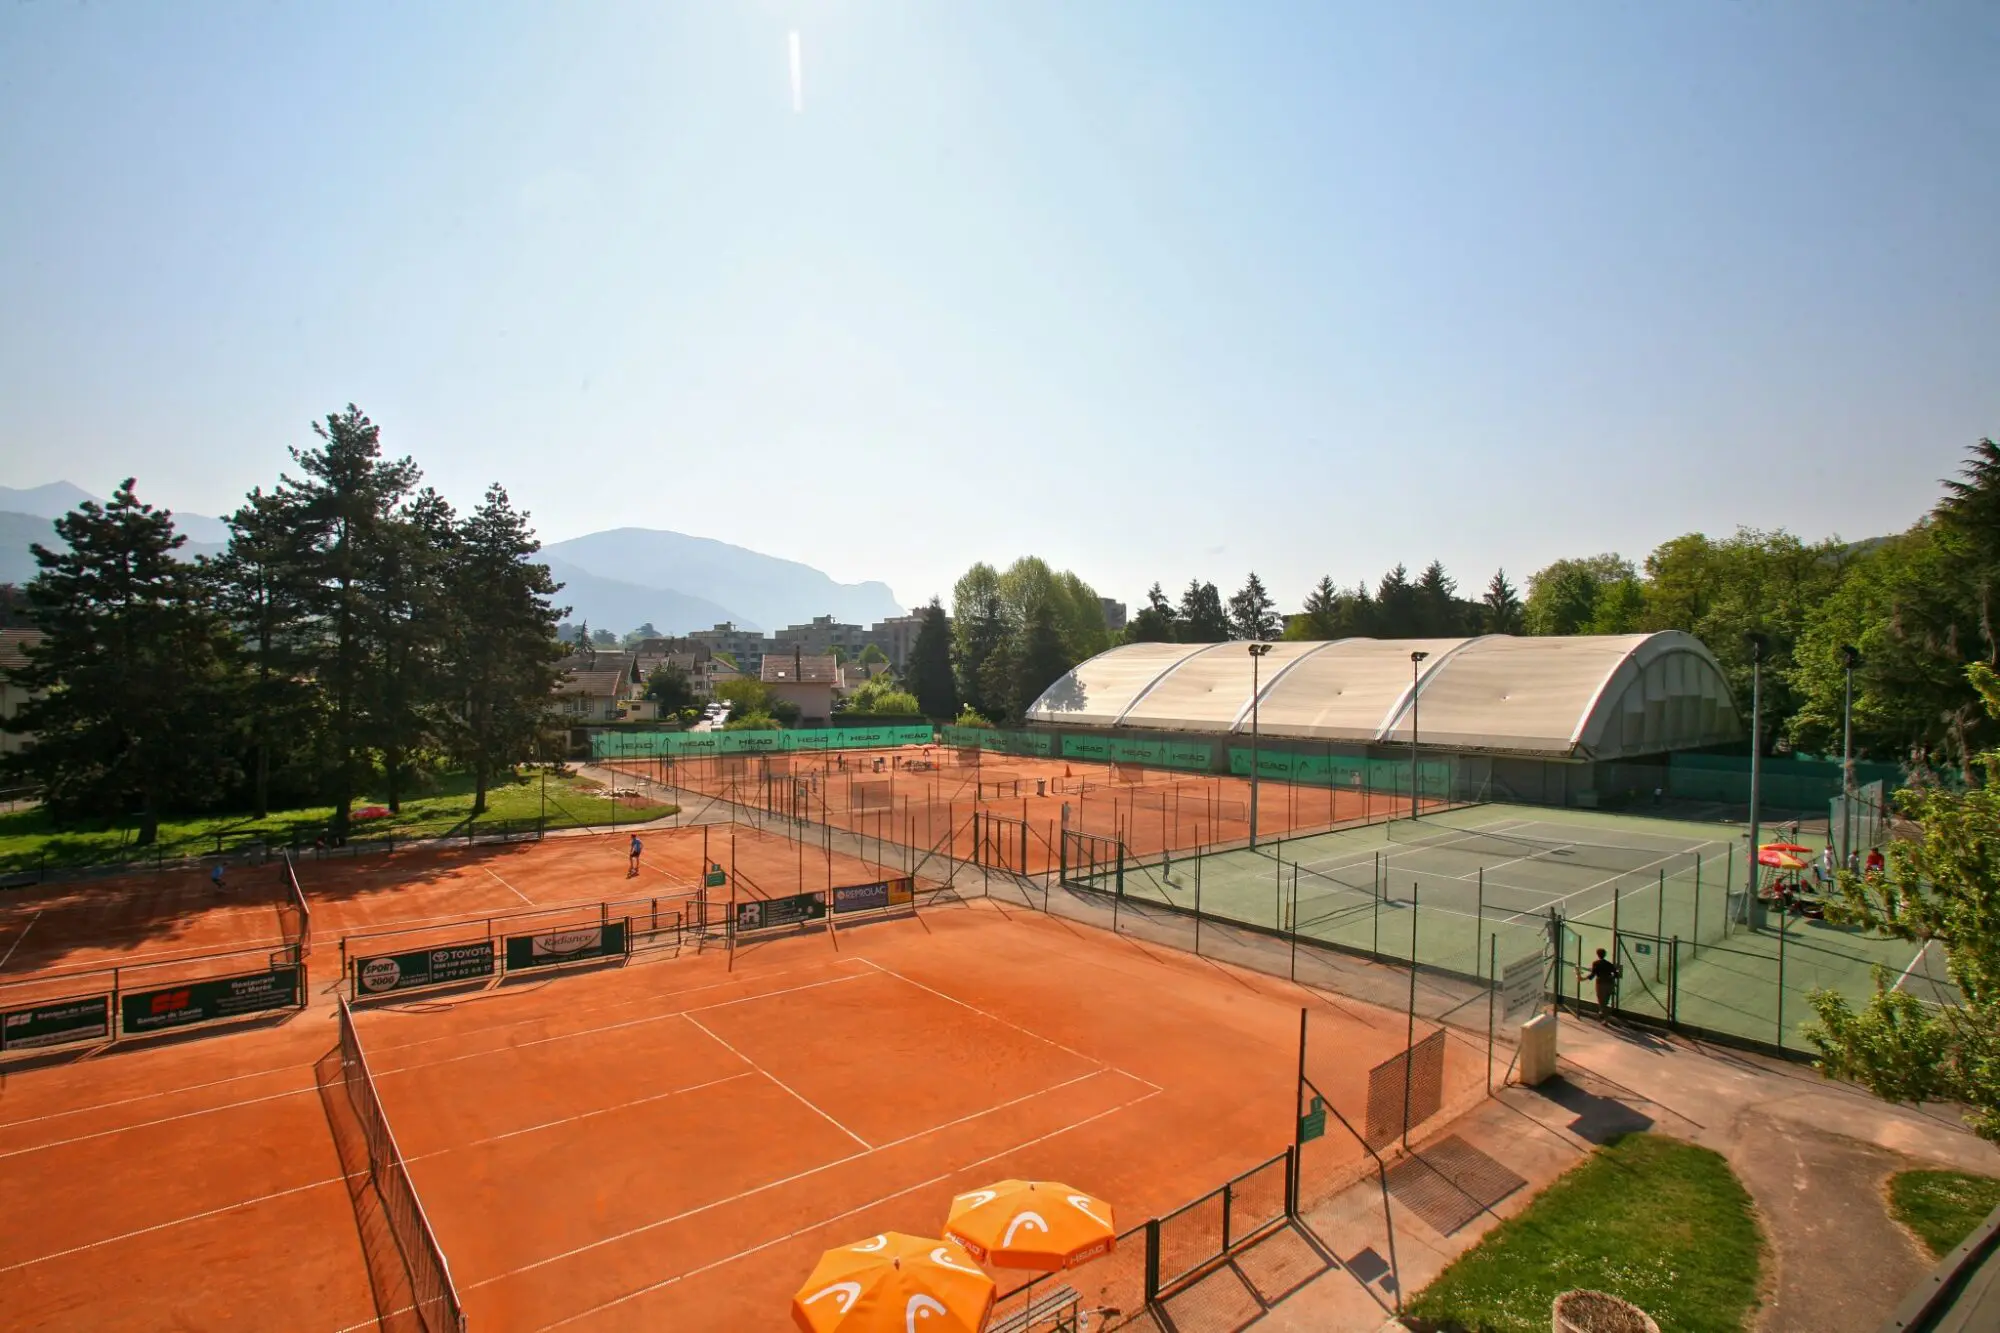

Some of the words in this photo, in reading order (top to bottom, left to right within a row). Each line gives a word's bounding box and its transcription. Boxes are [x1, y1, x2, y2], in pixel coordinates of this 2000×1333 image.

[615, 742, 654, 750] HEAD
[678, 740, 716, 748] HEAD
[1076, 745, 1103, 753] HEAD
[1122, 749, 1152, 758] HEAD
[1172, 753, 1206, 761] HEAD
[544, 934, 593, 947] Radiance
[450, 947, 492, 959] TOYOTA
[366, 962, 396, 974] SPORT
[371, 975, 395, 986] 2000
[945, 1232, 981, 1254] HEAD
[1069, 1244, 1105, 1265] HEAD
